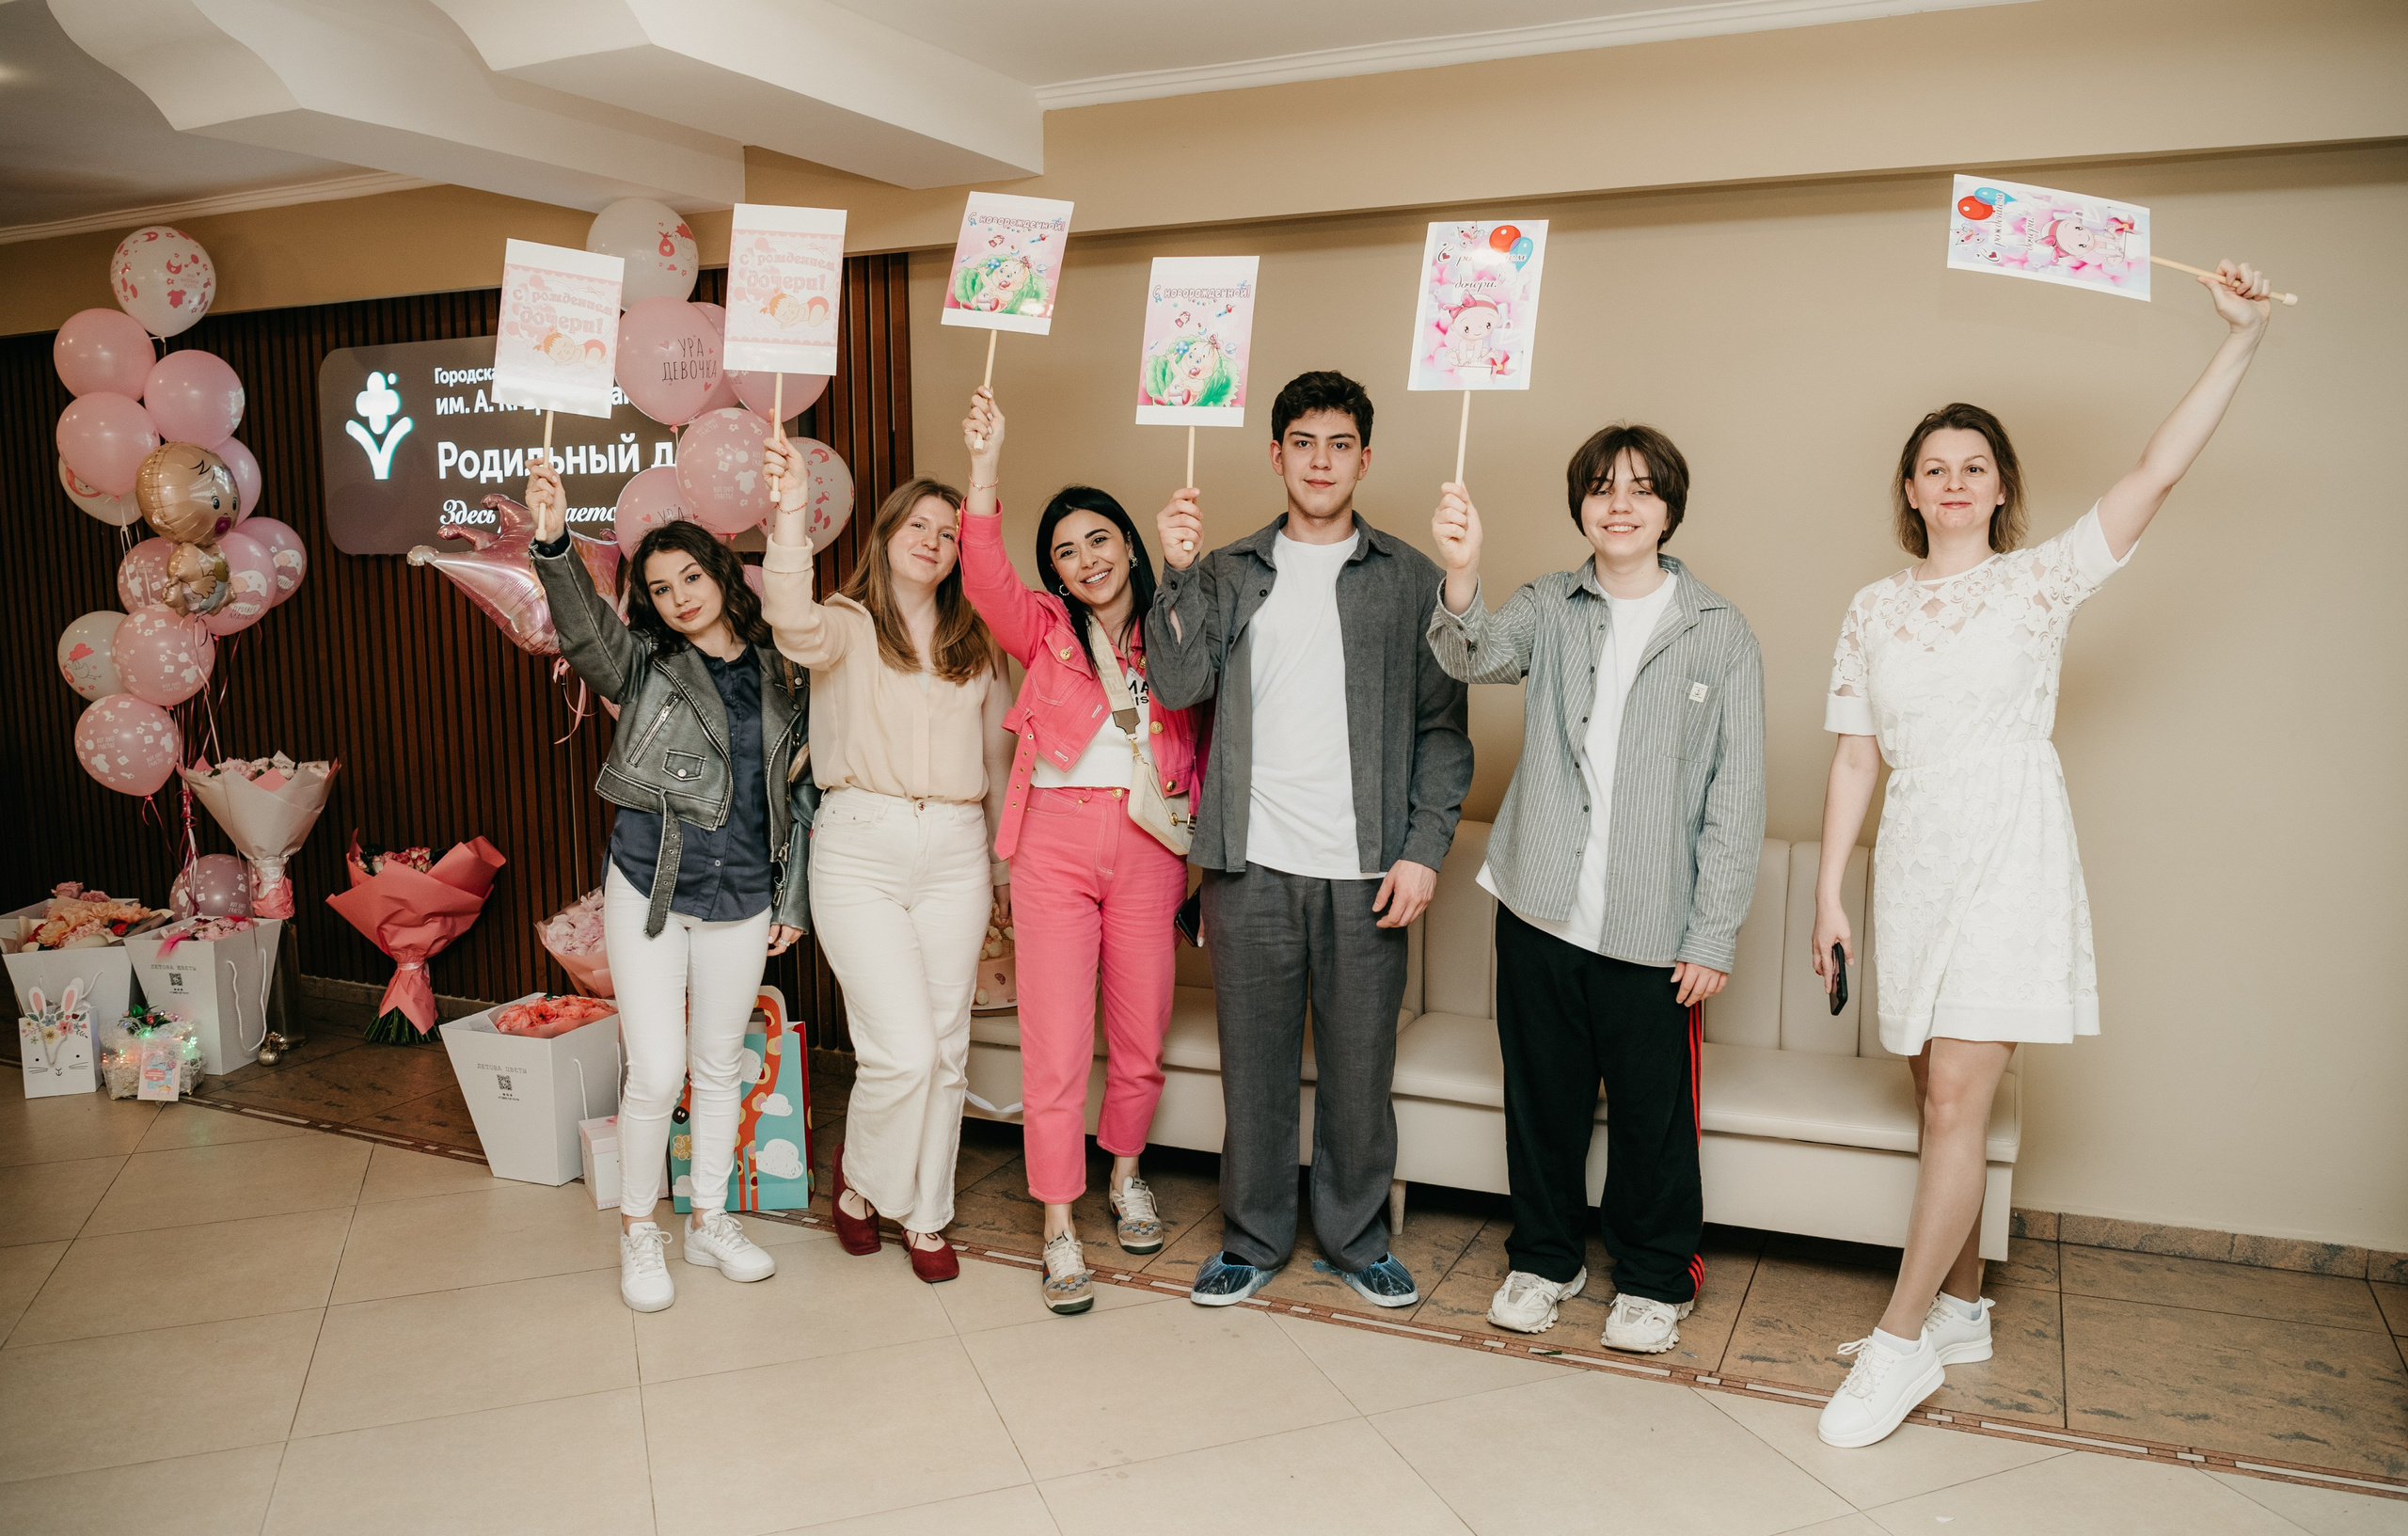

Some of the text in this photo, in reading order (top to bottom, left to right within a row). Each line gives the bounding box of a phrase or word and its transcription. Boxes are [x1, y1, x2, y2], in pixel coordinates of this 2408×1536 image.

[747, 269, 827, 293] дочери!
[520, 305, 604, 335] дочери!
[677, 338, 705, 357] УРА
[661, 359, 717, 382] ДЕВОЧКА
[436, 397, 469, 415] им.
[439, 499, 497, 525] Здесь
[477, 1063, 502, 1071] ЛЕТОВА
